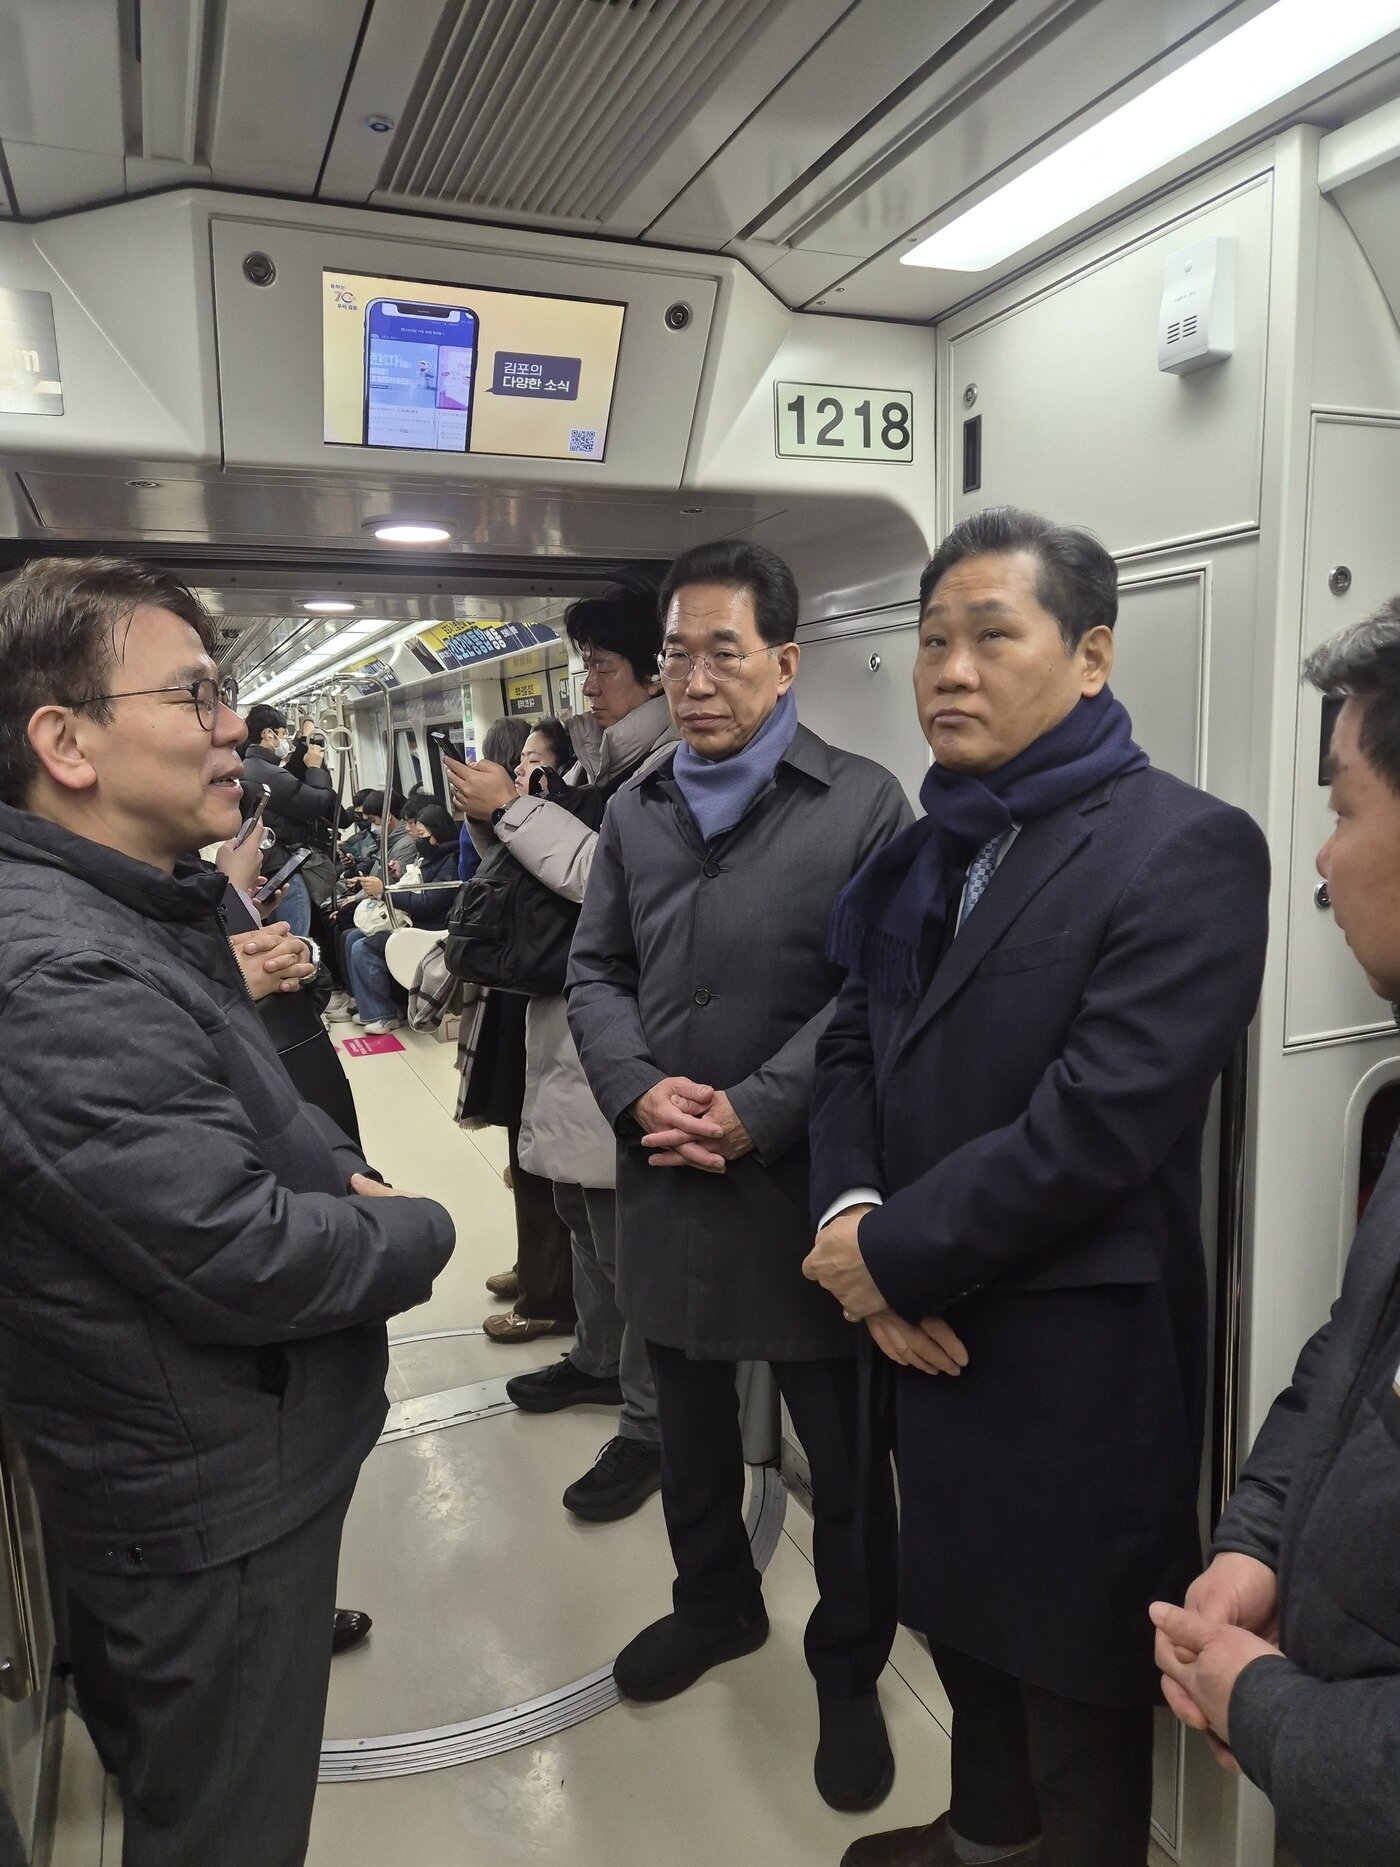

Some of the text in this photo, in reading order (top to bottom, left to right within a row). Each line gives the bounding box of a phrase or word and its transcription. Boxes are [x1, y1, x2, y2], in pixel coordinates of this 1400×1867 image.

[503, 361, 543, 377] 김포의
[502, 376, 570, 393] 다양한 소식
[787, 395, 910, 451] 1218
